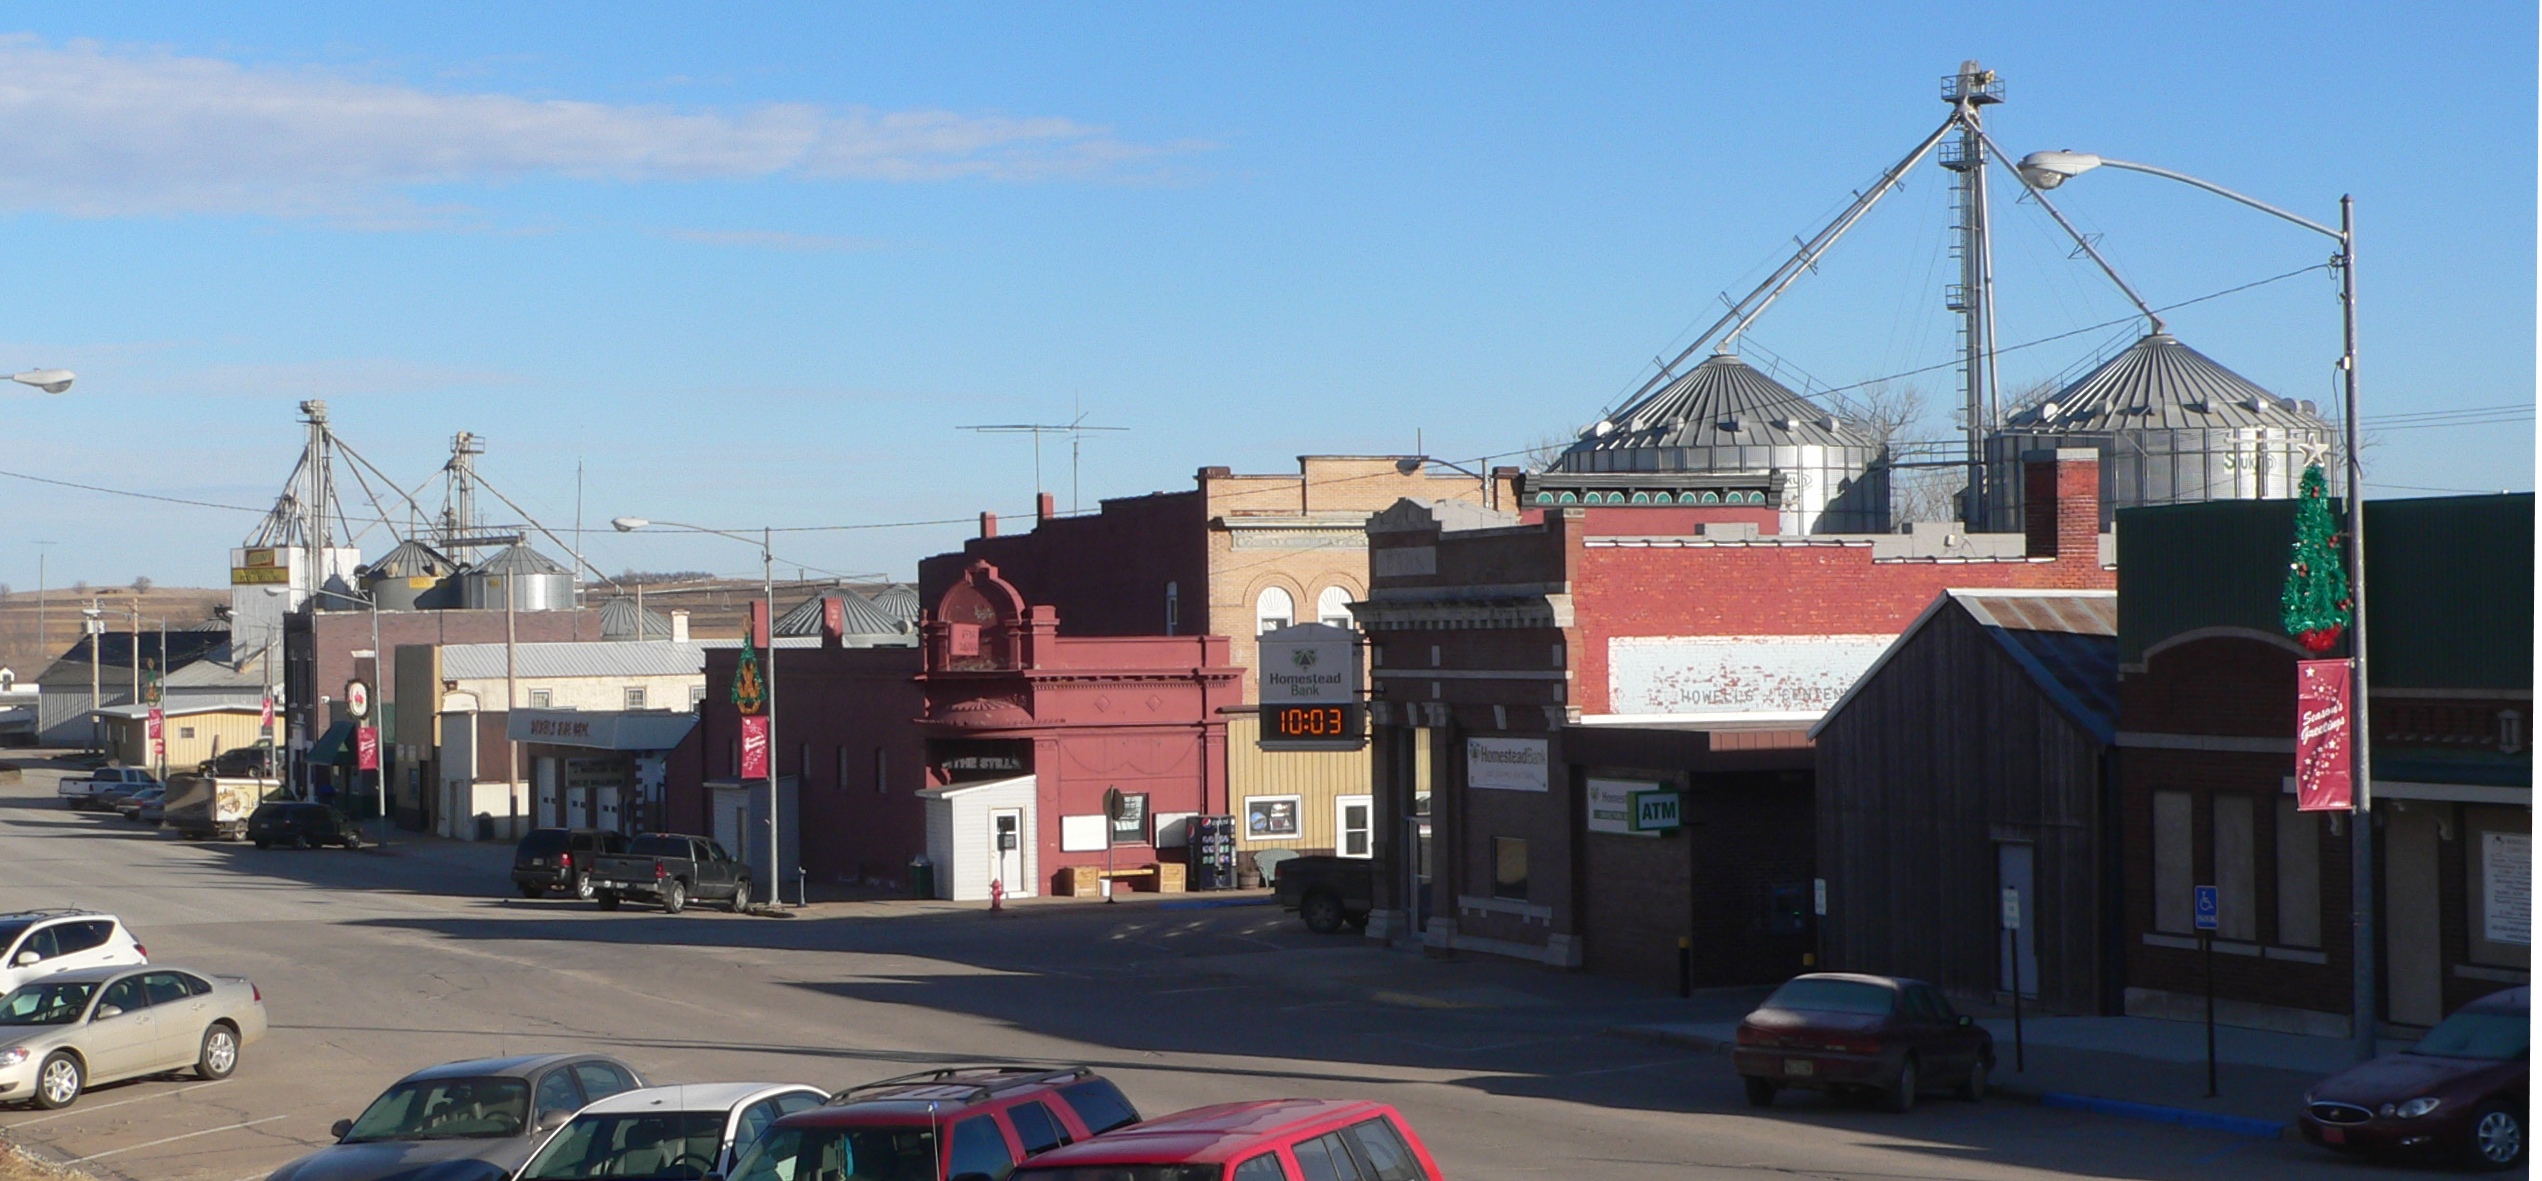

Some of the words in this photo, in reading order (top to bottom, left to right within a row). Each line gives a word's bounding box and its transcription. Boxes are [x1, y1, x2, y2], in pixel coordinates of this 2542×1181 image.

[1269, 673, 1342, 684] Homestead
[1291, 685, 1320, 696] Bank
[1680, 688, 1754, 704] HOWELLS
[1281, 708, 1342, 735] 10:03
[2302, 700, 2344, 726] Season's
[2301, 716, 2346, 746] Greetings
[1642, 801, 1676, 820] ATM
